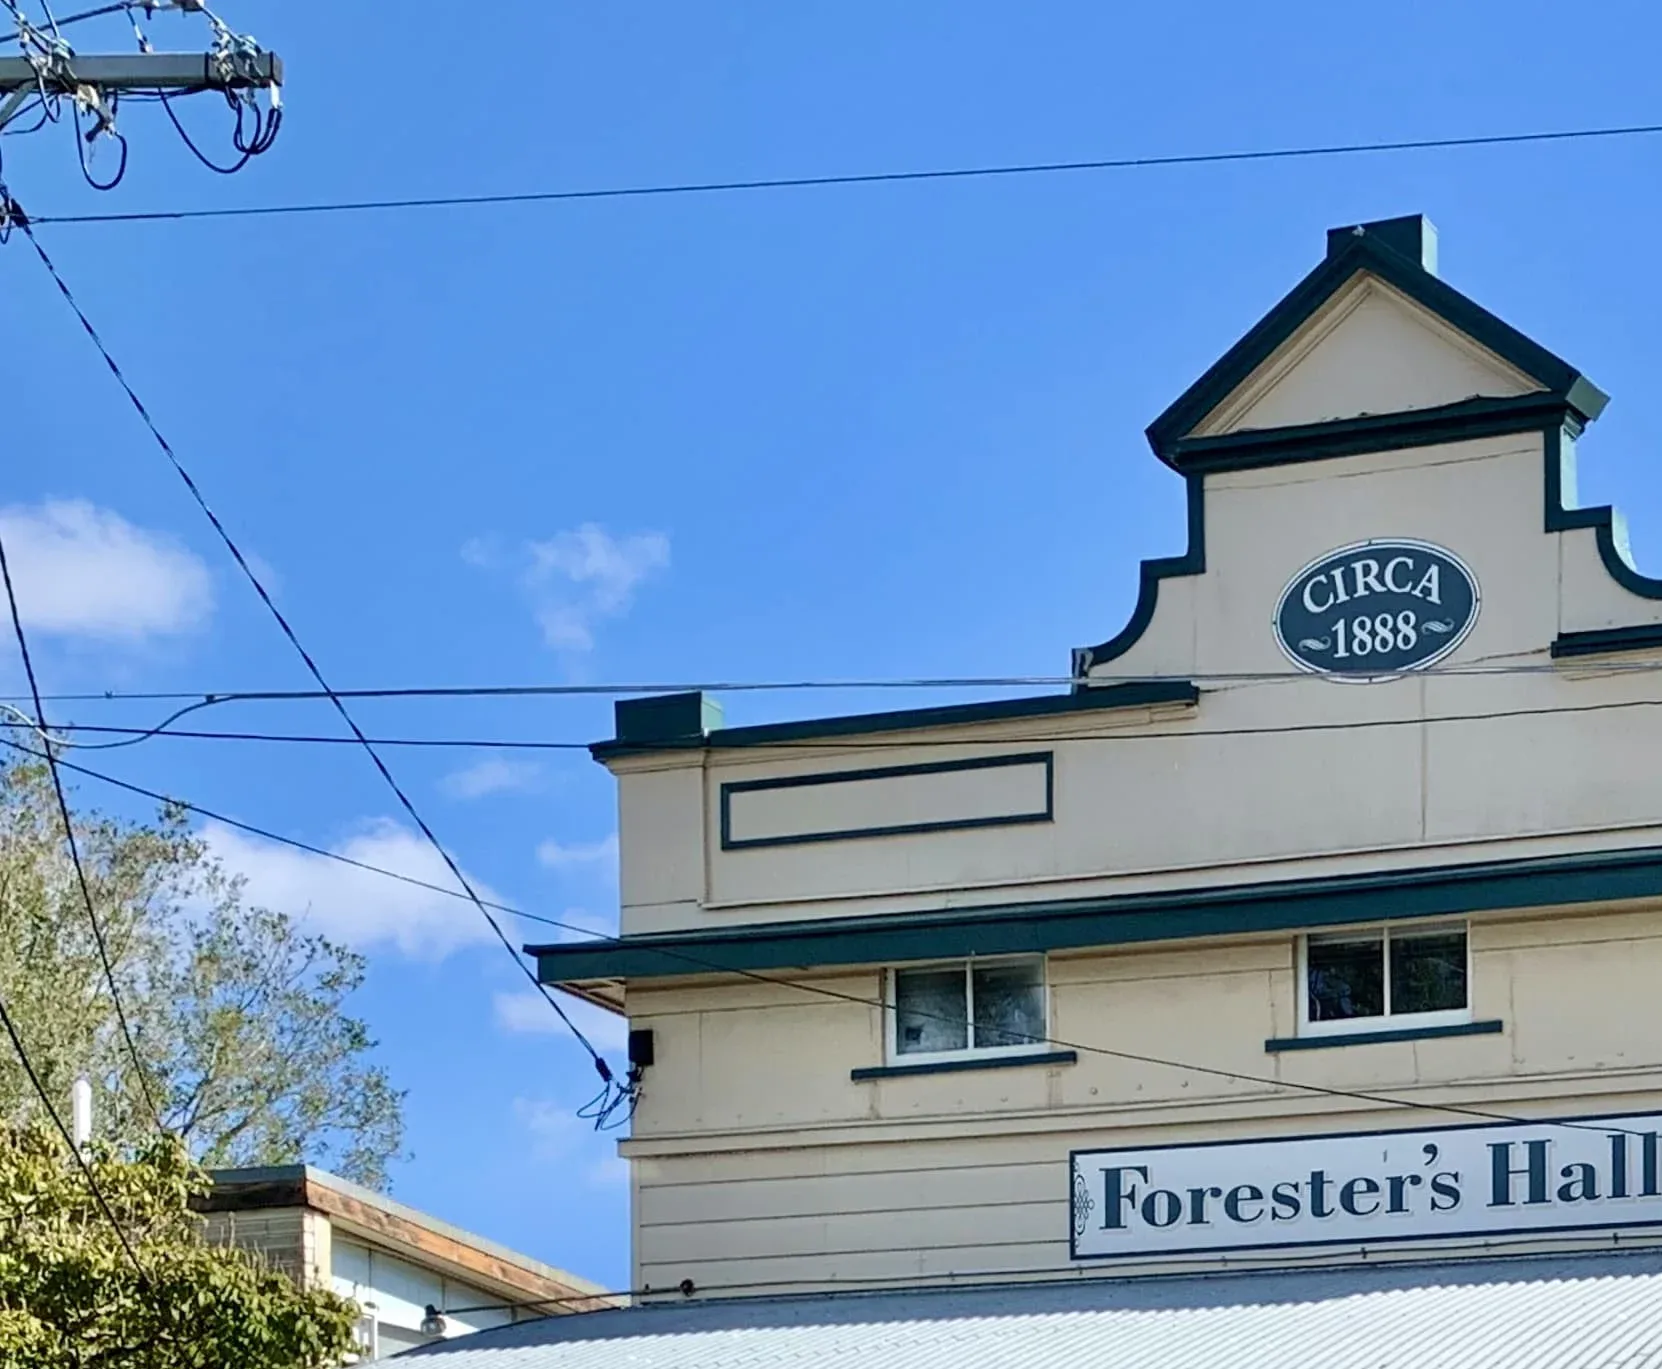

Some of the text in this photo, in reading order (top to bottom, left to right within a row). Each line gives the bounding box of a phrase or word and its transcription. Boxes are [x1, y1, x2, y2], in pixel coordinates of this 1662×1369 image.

[1302, 556, 1442, 614] CIRCA
[1331, 610, 1418, 658] 1888
[1099, 1142, 1462, 1230] Forester's
